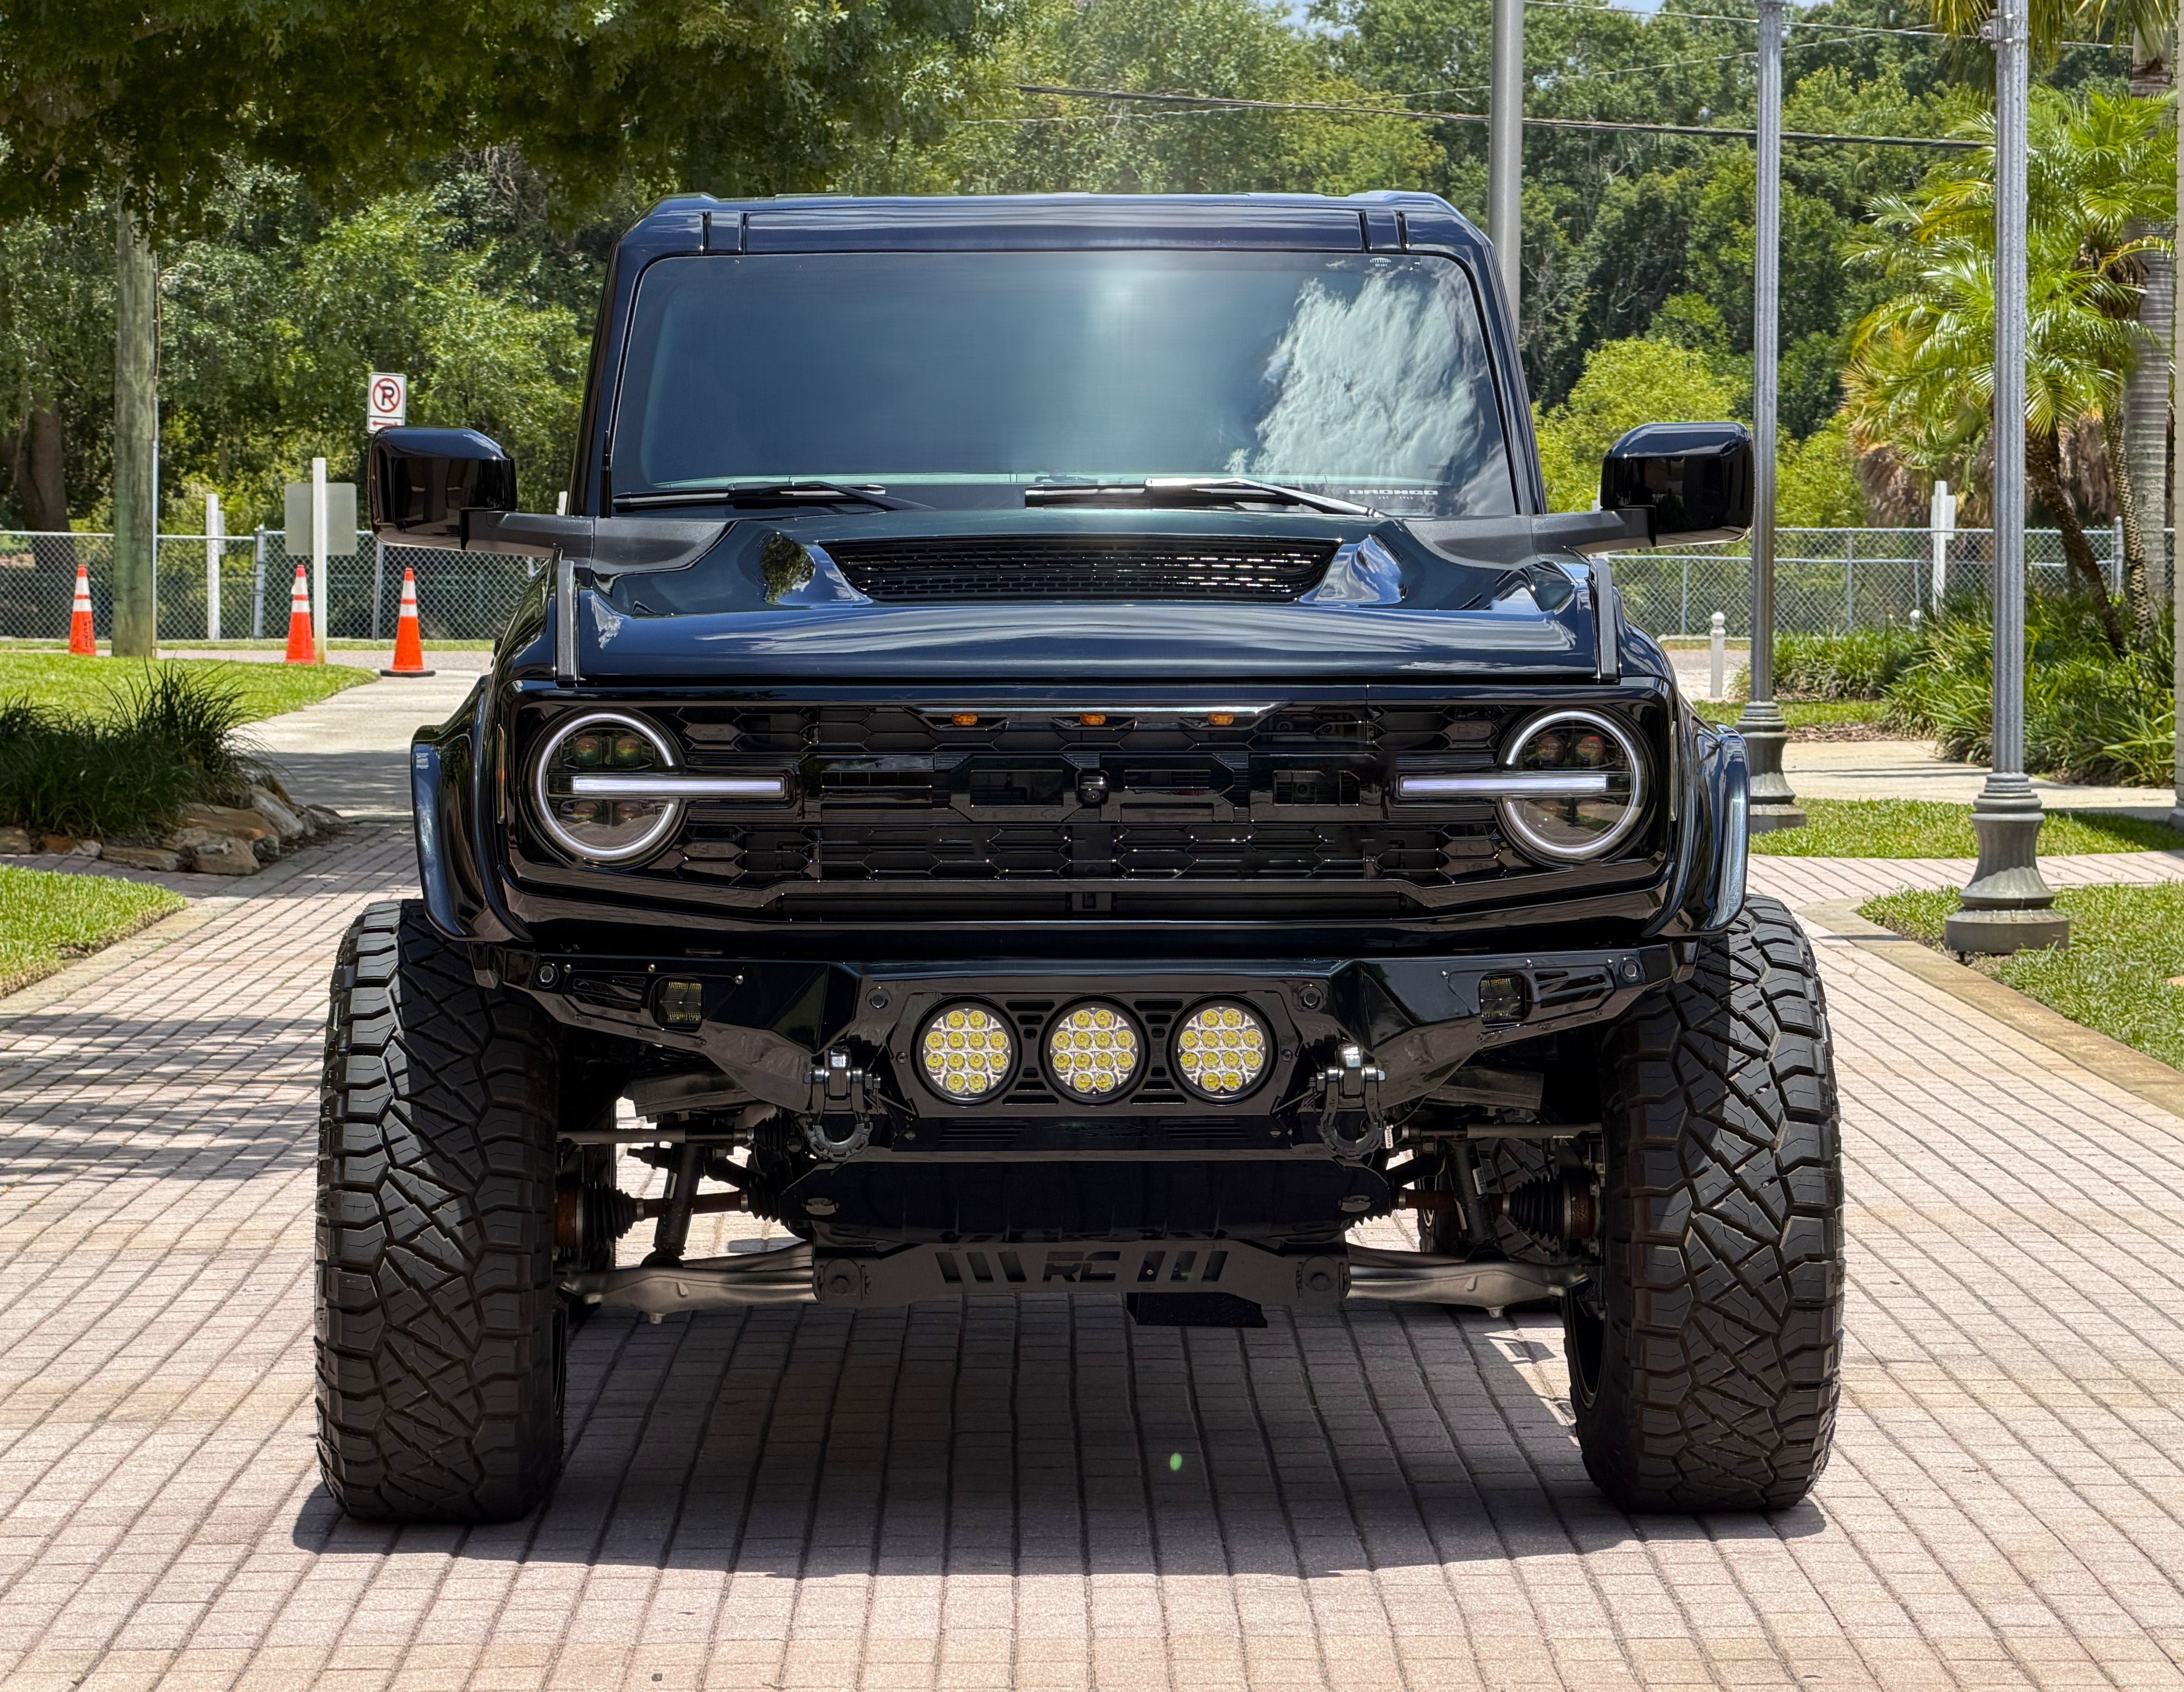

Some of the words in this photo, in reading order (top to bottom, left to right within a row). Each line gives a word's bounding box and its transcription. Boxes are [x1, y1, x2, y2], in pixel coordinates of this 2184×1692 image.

[381, 386, 395, 406] P
[800, 754, 1386, 823] FORD
[1042, 1251, 1121, 1282] RC
